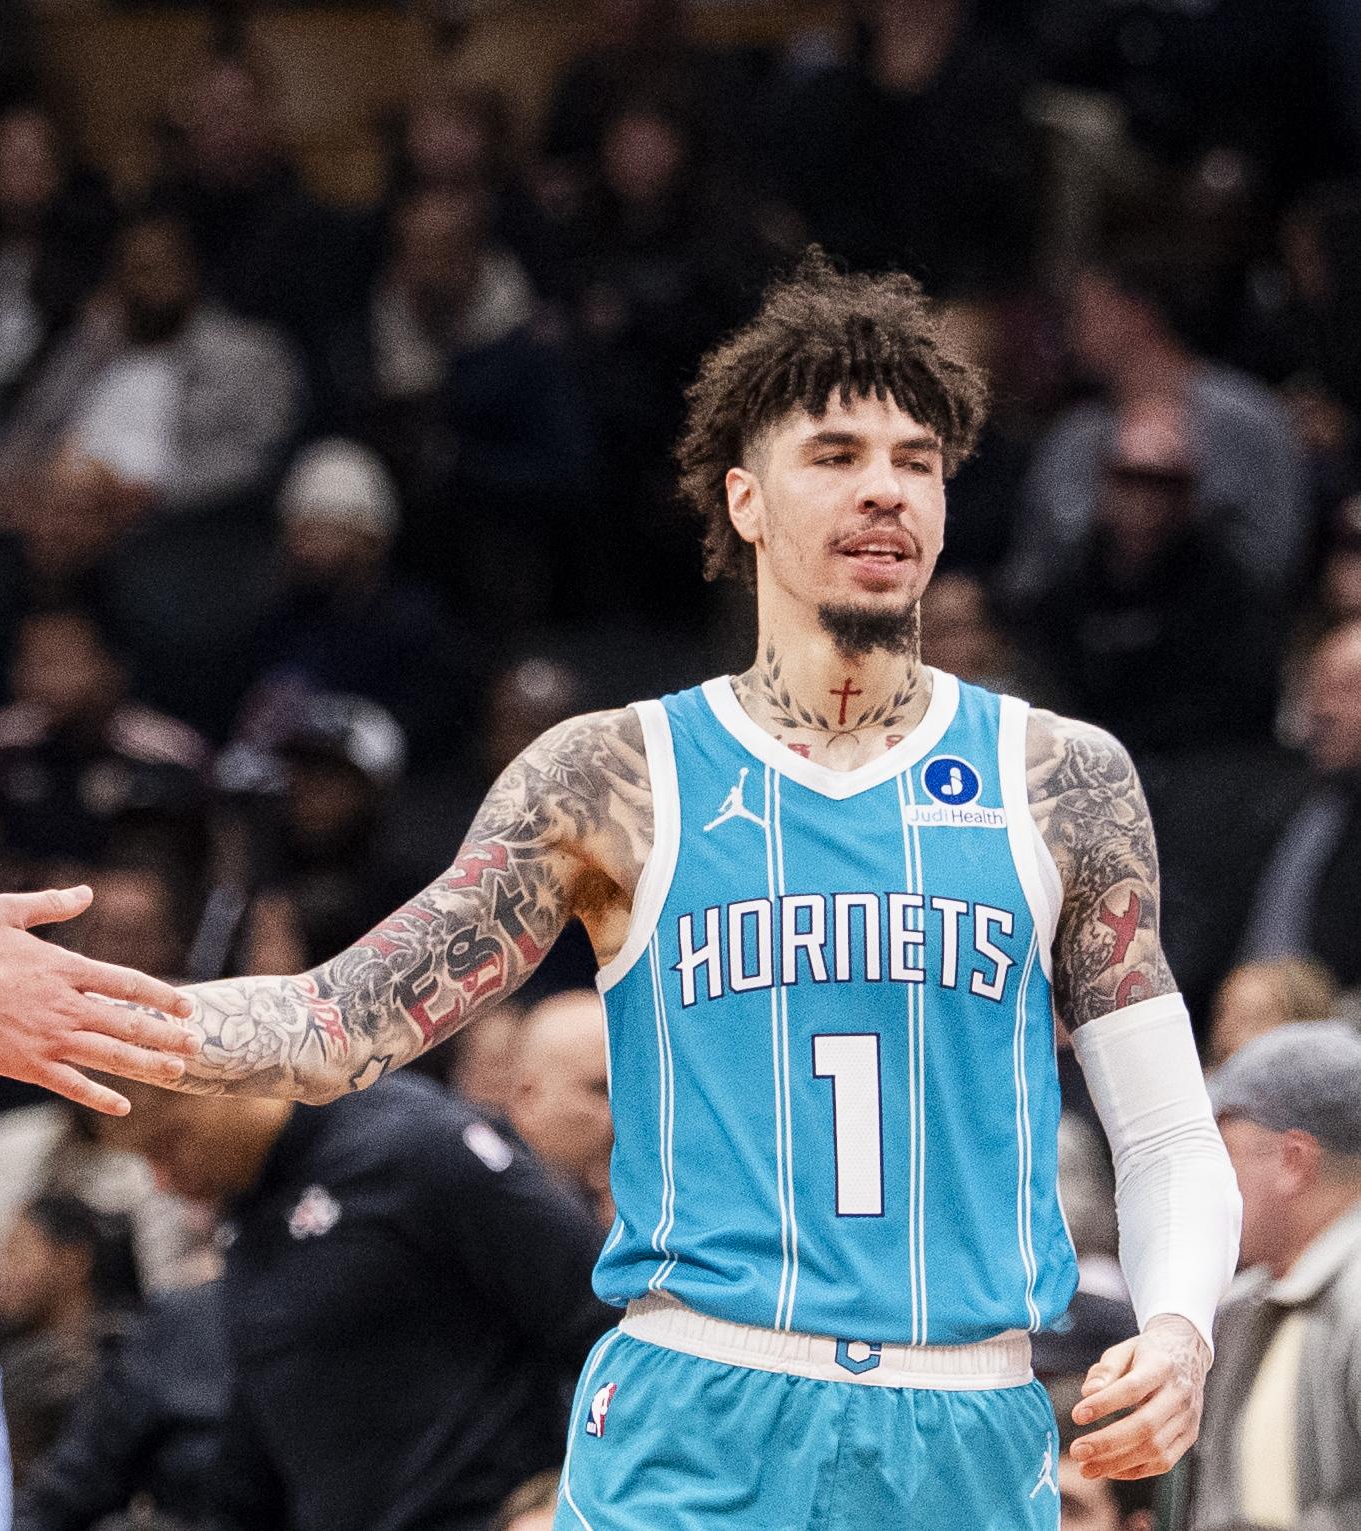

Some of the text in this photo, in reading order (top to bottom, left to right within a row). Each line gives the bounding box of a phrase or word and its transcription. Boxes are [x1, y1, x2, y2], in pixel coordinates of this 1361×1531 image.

[911, 808, 1004, 825] Judi Health
[670, 891, 1018, 1008] HORNETS
[811, 1033, 886, 1218] 1
